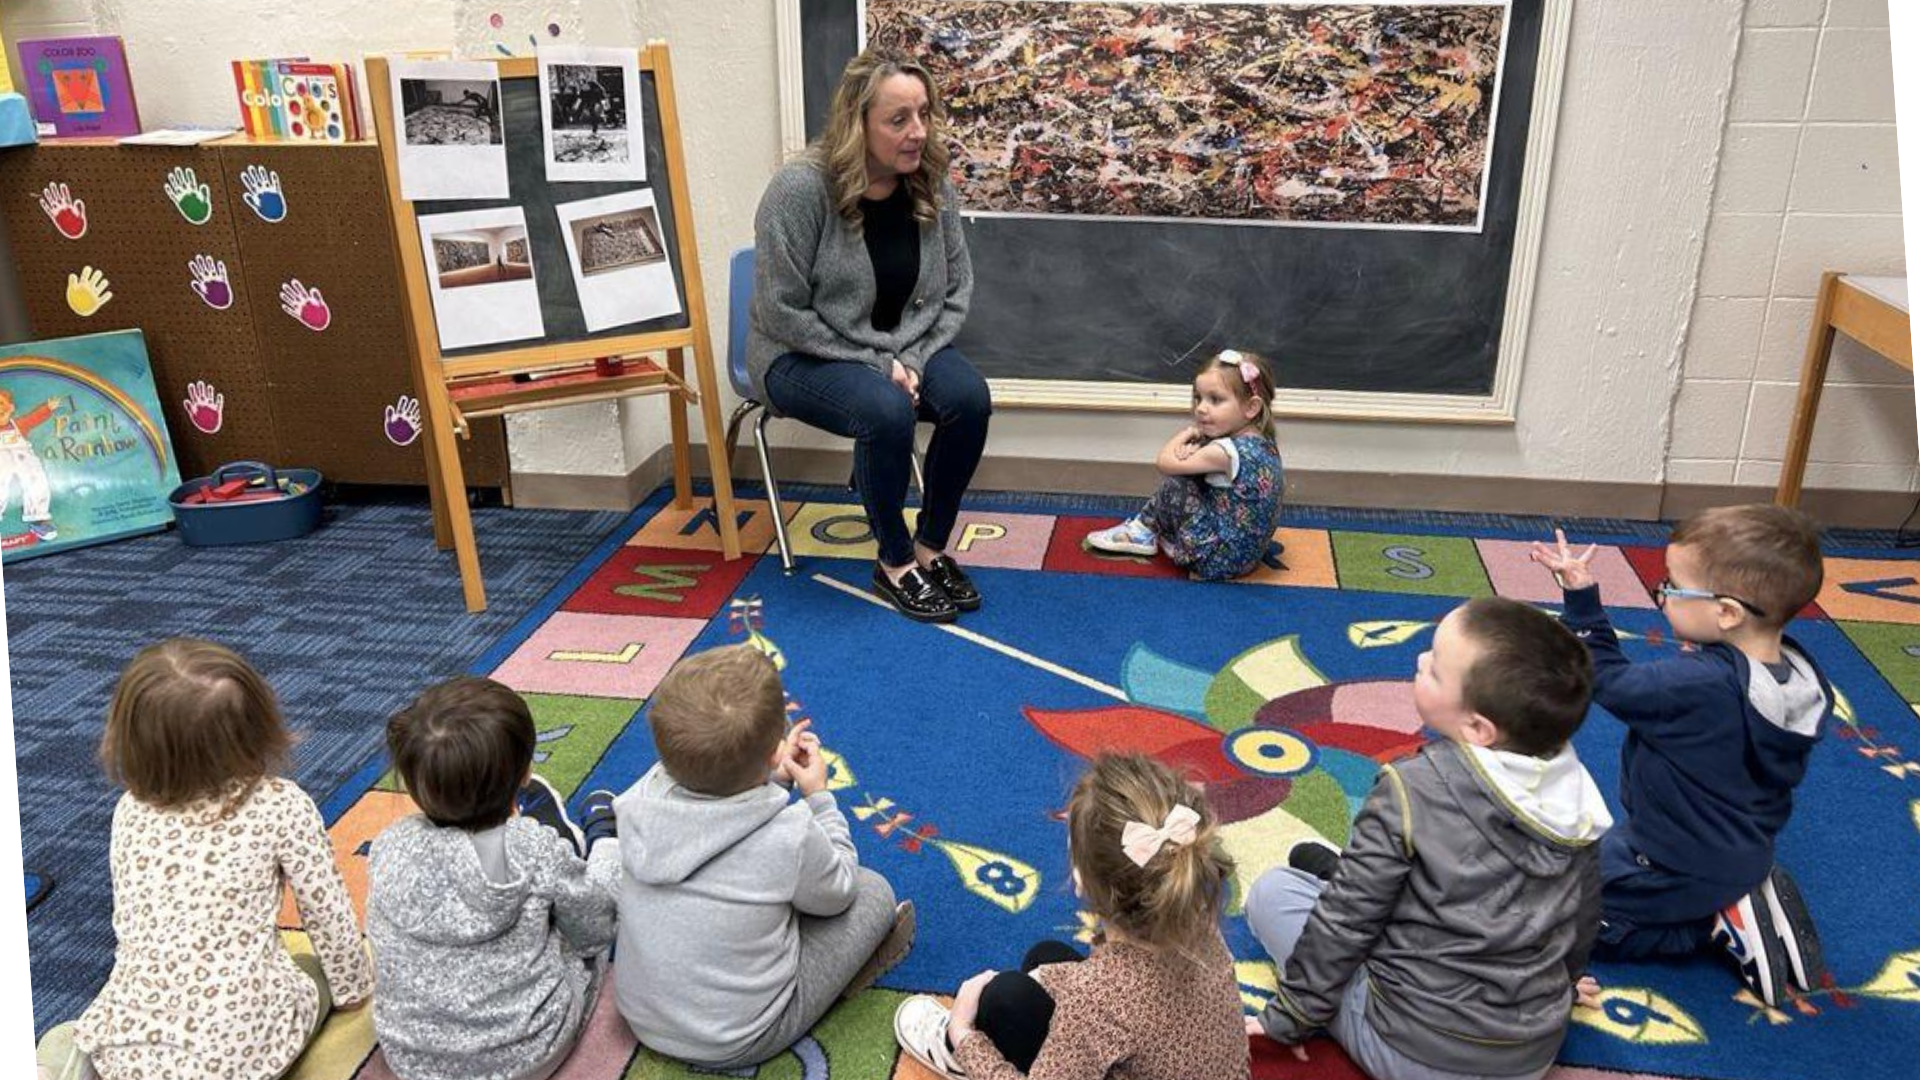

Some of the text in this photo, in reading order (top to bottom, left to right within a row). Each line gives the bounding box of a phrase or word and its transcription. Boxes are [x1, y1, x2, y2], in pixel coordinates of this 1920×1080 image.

[43, 46, 96, 57] COLOR ZOO
[67, 394, 77, 413] I
[54, 412, 122, 437] Paint
[44, 435, 138, 462] a Rainbow
[955, 523, 1007, 552] P
[1382, 545, 1435, 579] S
[1838, 577, 1920, 604] V
[546, 642, 646, 664] L
[976, 860, 1027, 896] 8
